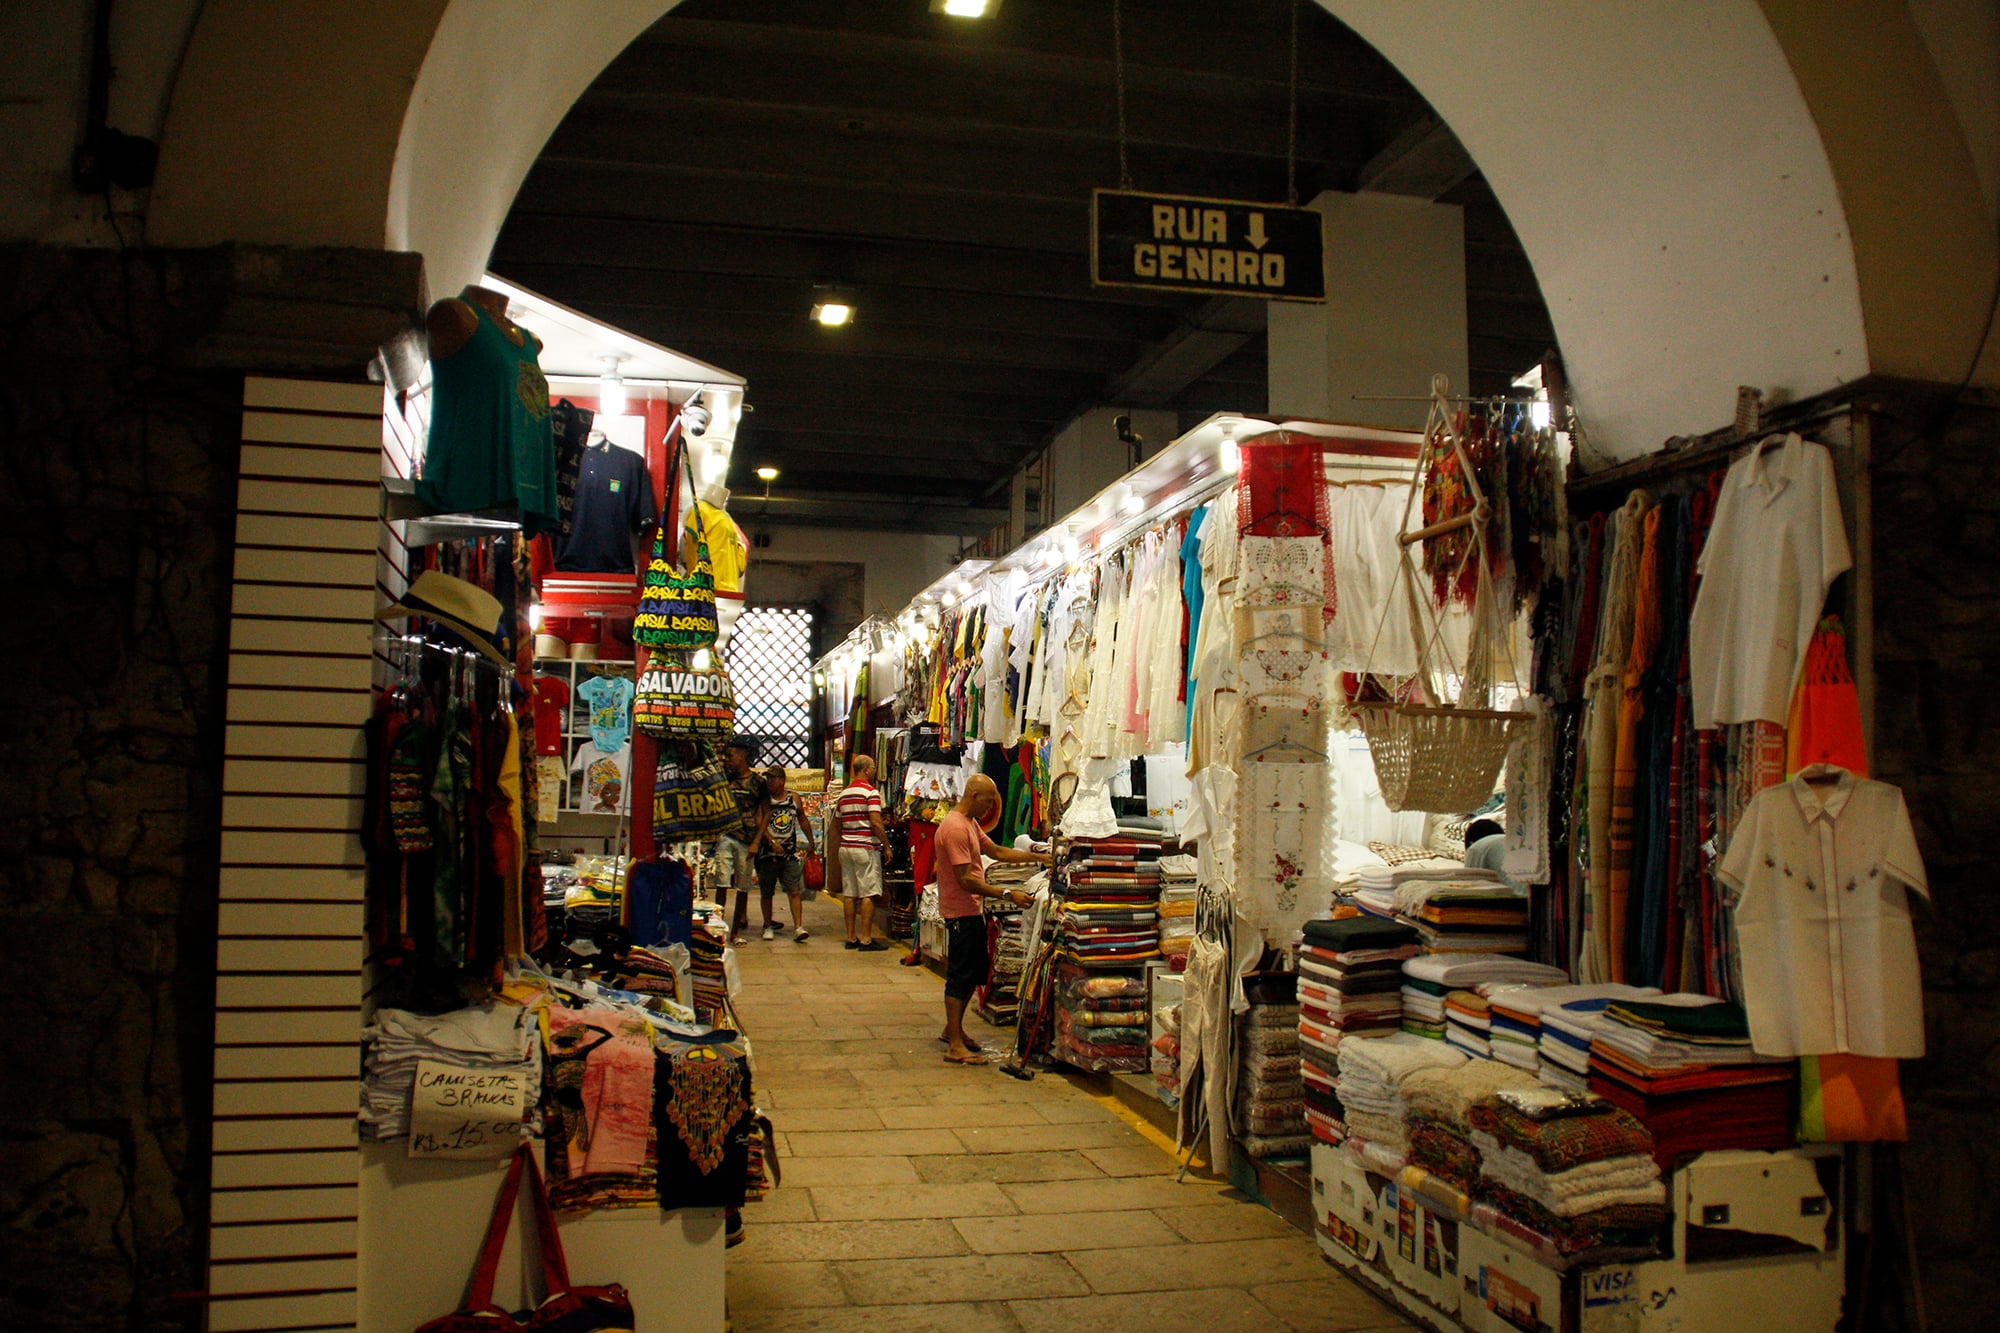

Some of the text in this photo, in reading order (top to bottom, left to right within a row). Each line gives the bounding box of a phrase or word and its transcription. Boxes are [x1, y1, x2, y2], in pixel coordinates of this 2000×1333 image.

[1152, 204, 1227, 243] RUA
[1133, 243, 1285, 288] GENARO
[641, 671, 731, 698] SALVADOR
[677, 788, 736, 817] BRASIL
[419, 1071, 519, 1090] CAMISETAS
[435, 1088, 515, 1108] BRANCAS
